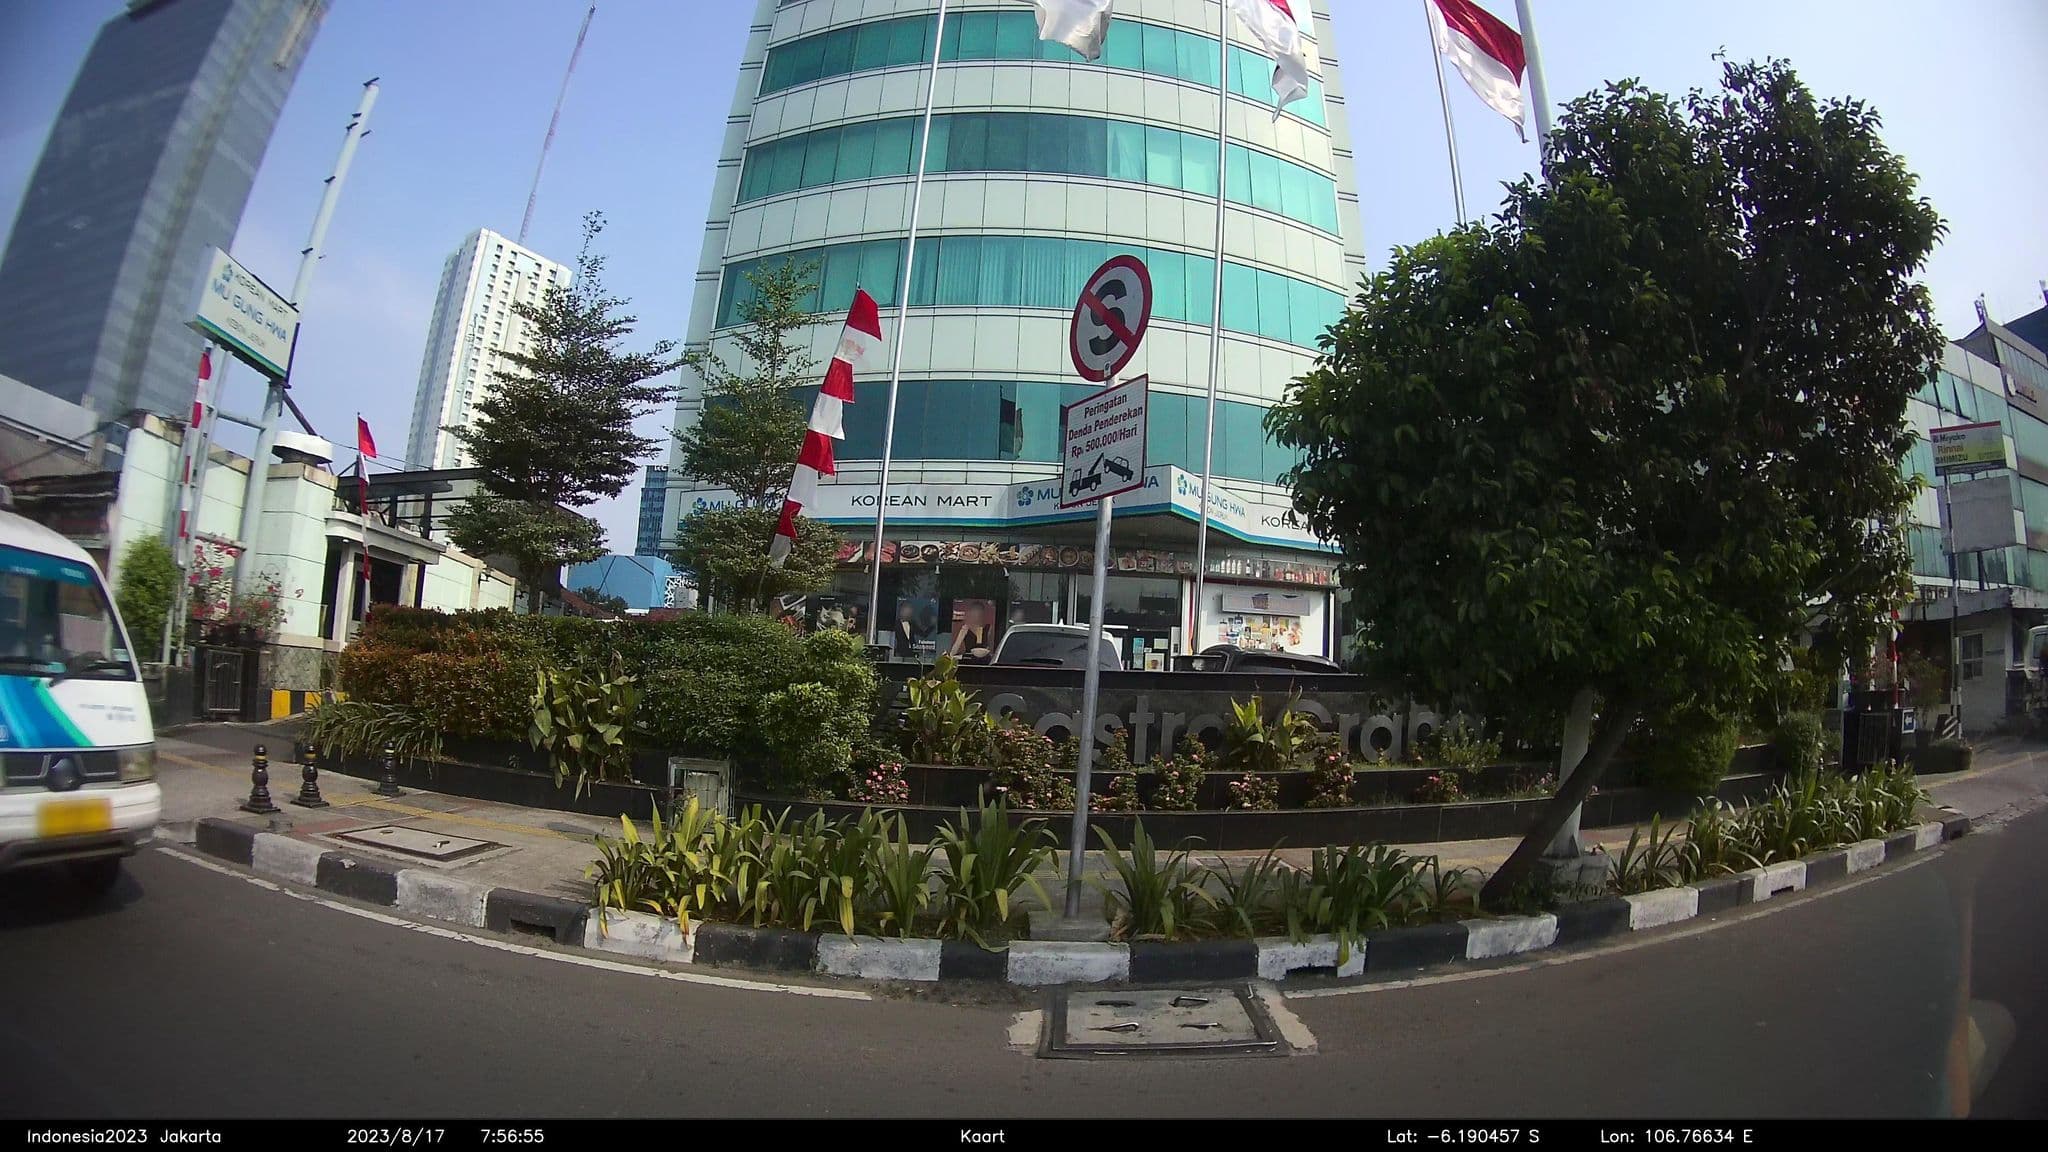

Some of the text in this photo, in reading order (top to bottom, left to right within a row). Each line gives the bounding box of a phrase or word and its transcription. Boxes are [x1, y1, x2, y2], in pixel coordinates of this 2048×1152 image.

[1084, 394, 1127, 418] Peringatan
[1068, 406, 1143, 441] Denda Penderekan
[937, 496, 992, 507] MART
[1229, 503, 1247, 518] HWA
